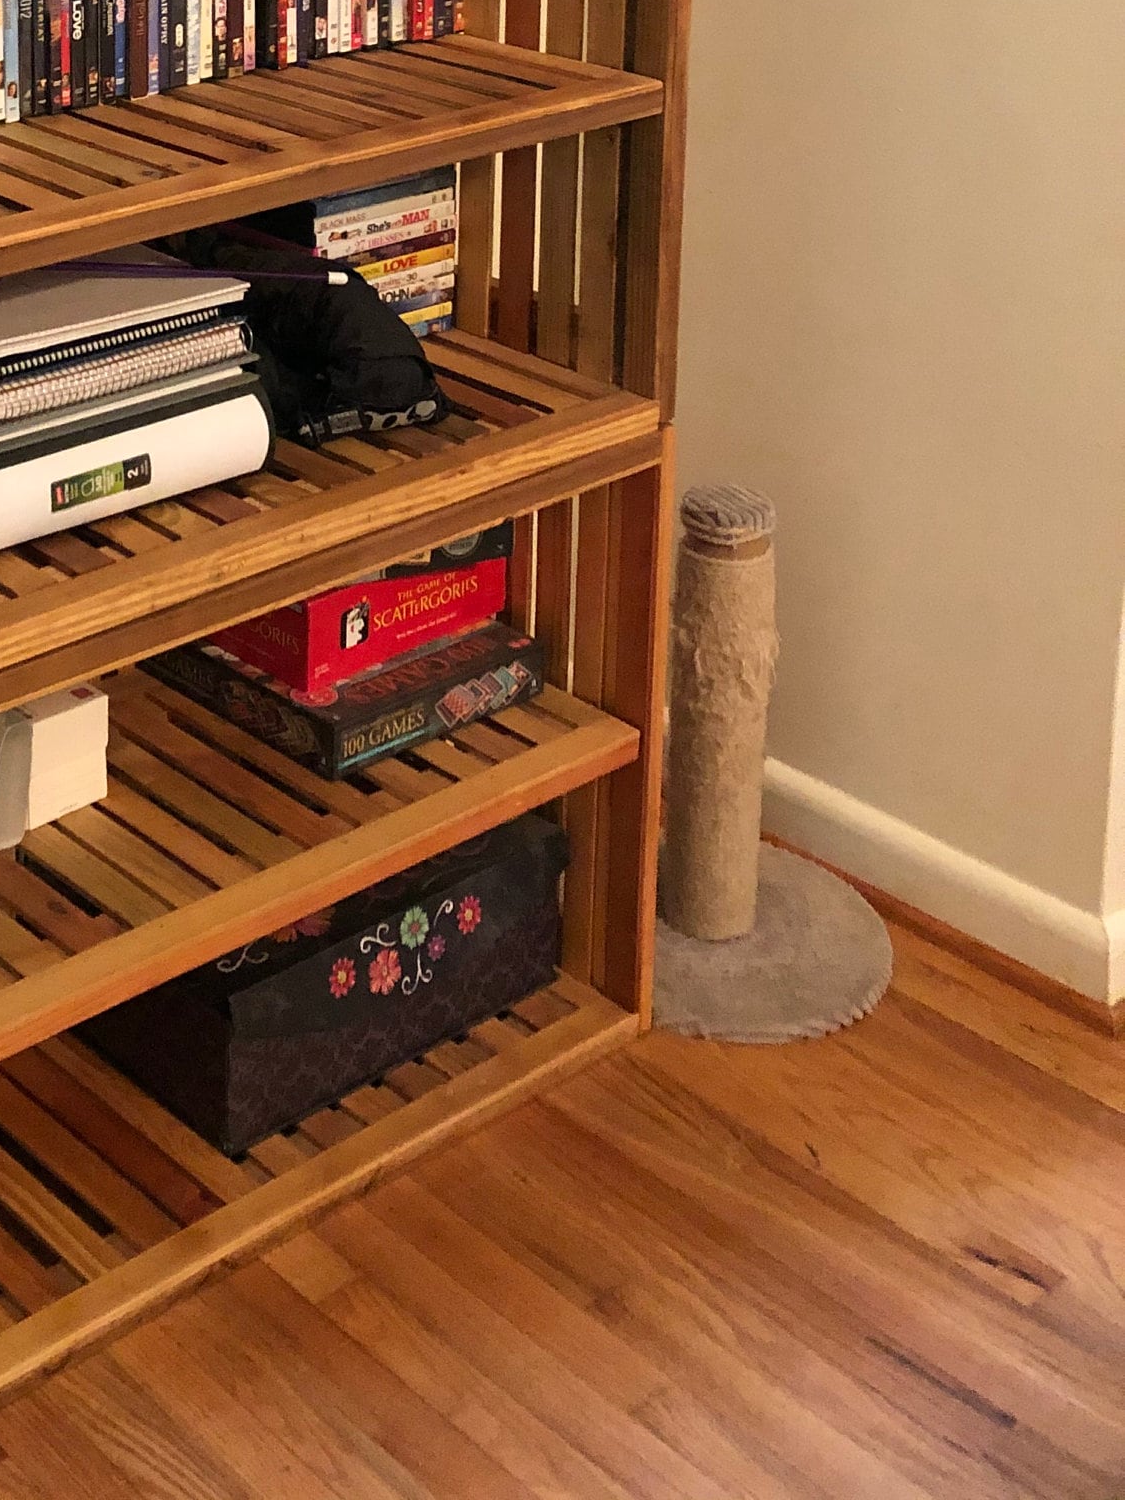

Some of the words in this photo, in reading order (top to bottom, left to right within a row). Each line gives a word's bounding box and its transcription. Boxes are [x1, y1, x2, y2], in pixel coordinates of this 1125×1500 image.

[367, 220, 391, 235] She's
[401, 208, 430, 226] MAN
[383, 255, 418, 273] LOVE
[405, 273, 418, 282] 30
[381, 288, 410, 303] JOHN
[127, 466, 139, 480] 2
[397, 590, 413, 602] THE
[416, 580, 440, 594] GAME
[444, 571, 457, 584] OF
[373, 575, 479, 632] SCATTERGORIES
[342, 733, 366, 758] 100
[369, 708, 426, 746] GAMES
